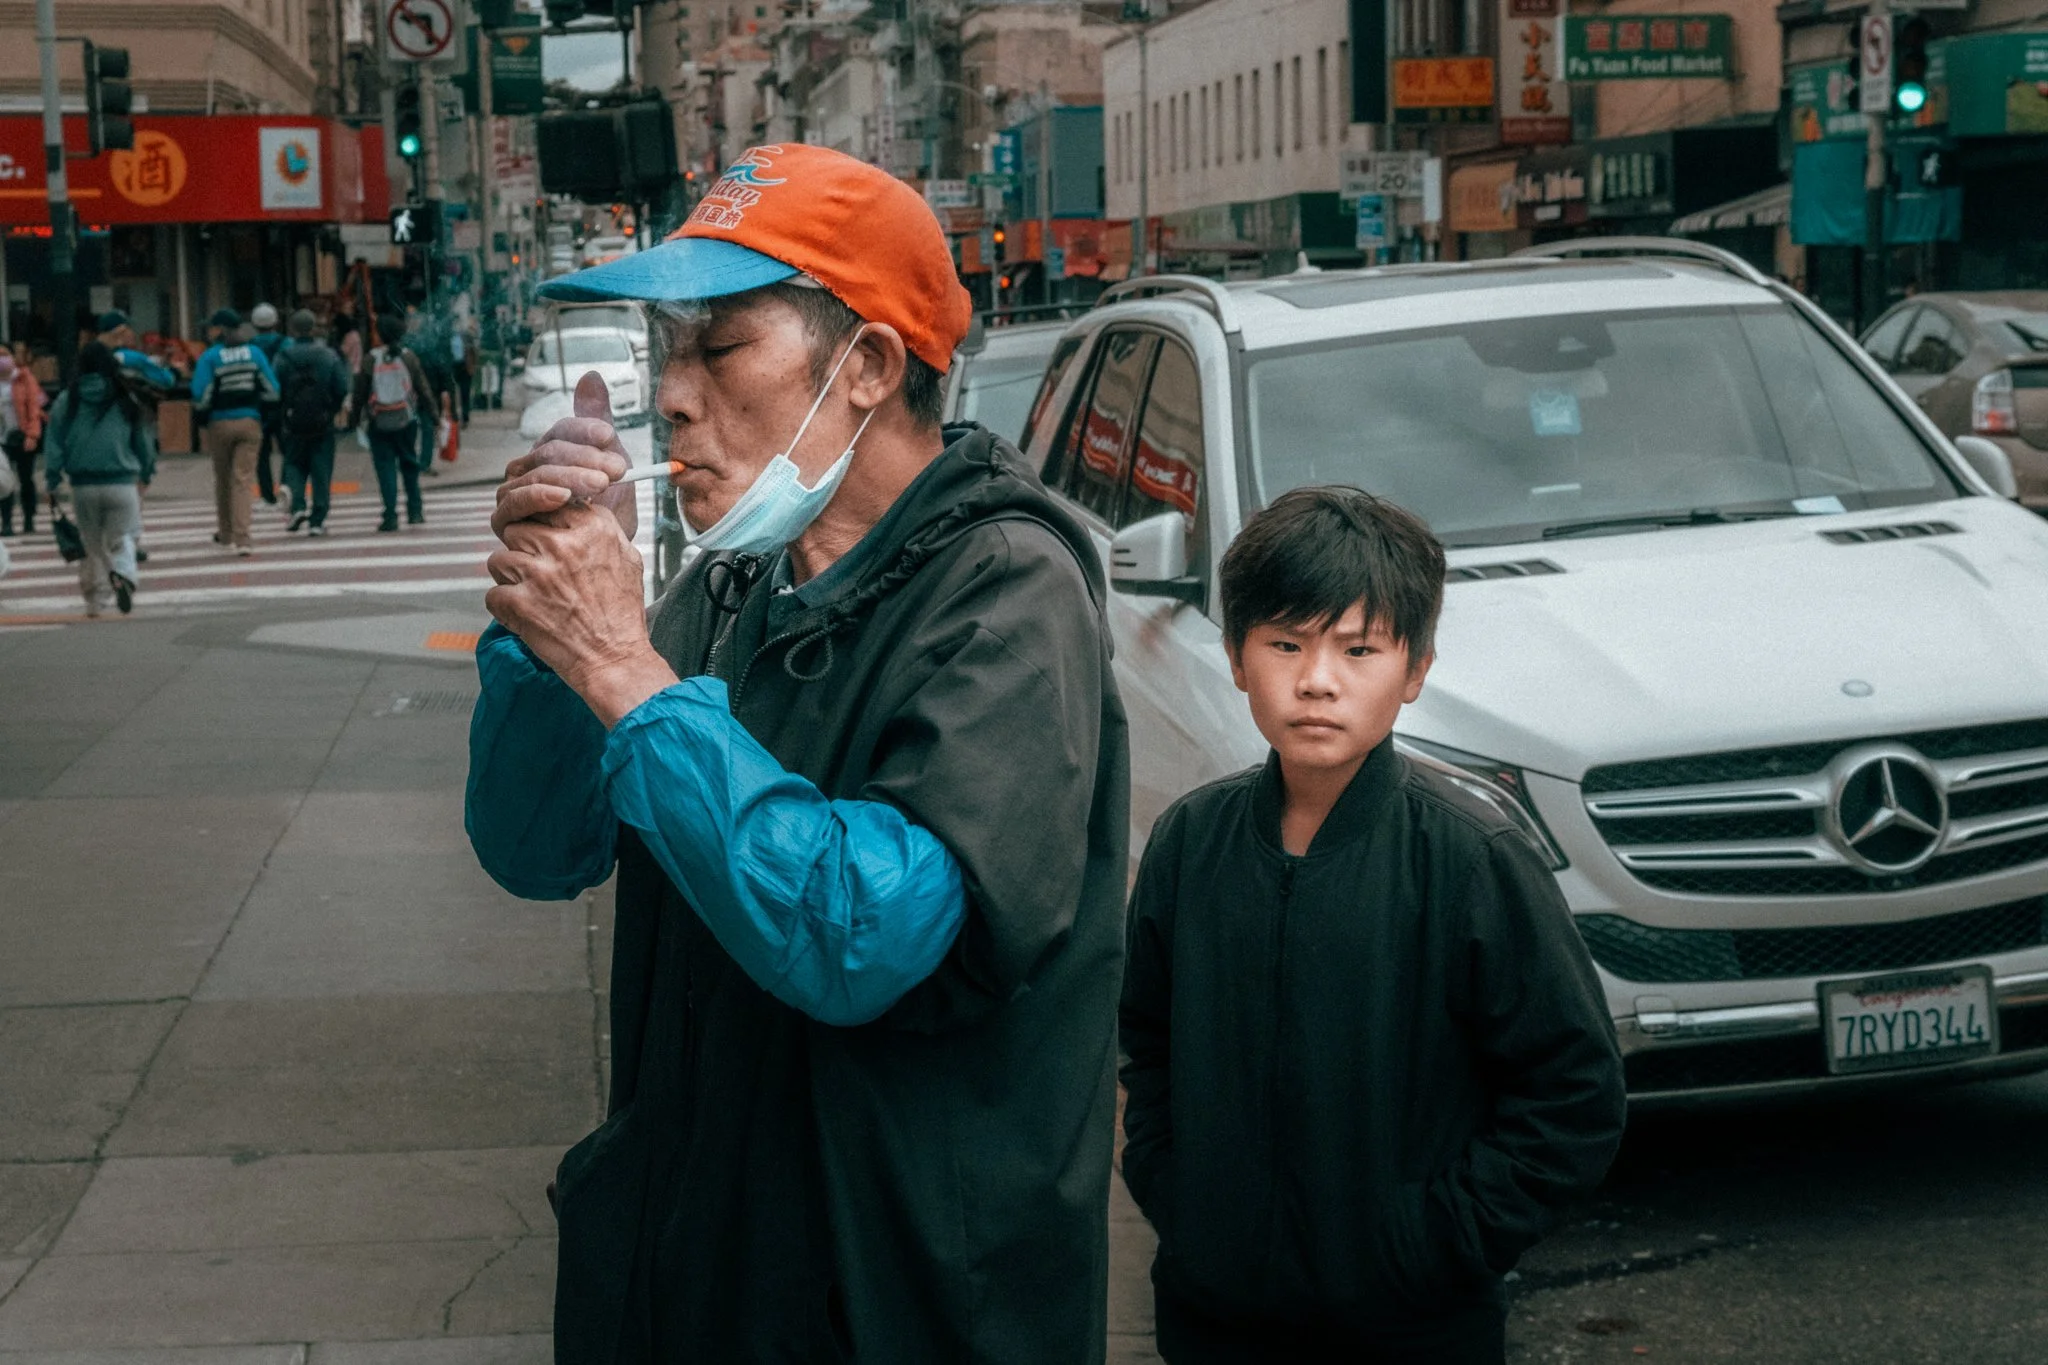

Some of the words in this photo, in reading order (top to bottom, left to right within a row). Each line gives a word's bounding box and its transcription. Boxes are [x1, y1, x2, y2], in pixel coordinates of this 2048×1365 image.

[1631, 56, 1668, 72] Food
[1671, 55, 1723, 72] Market
[1380, 173, 1407, 190] 20
[1837, 1003, 1984, 1058] 7RYD344
